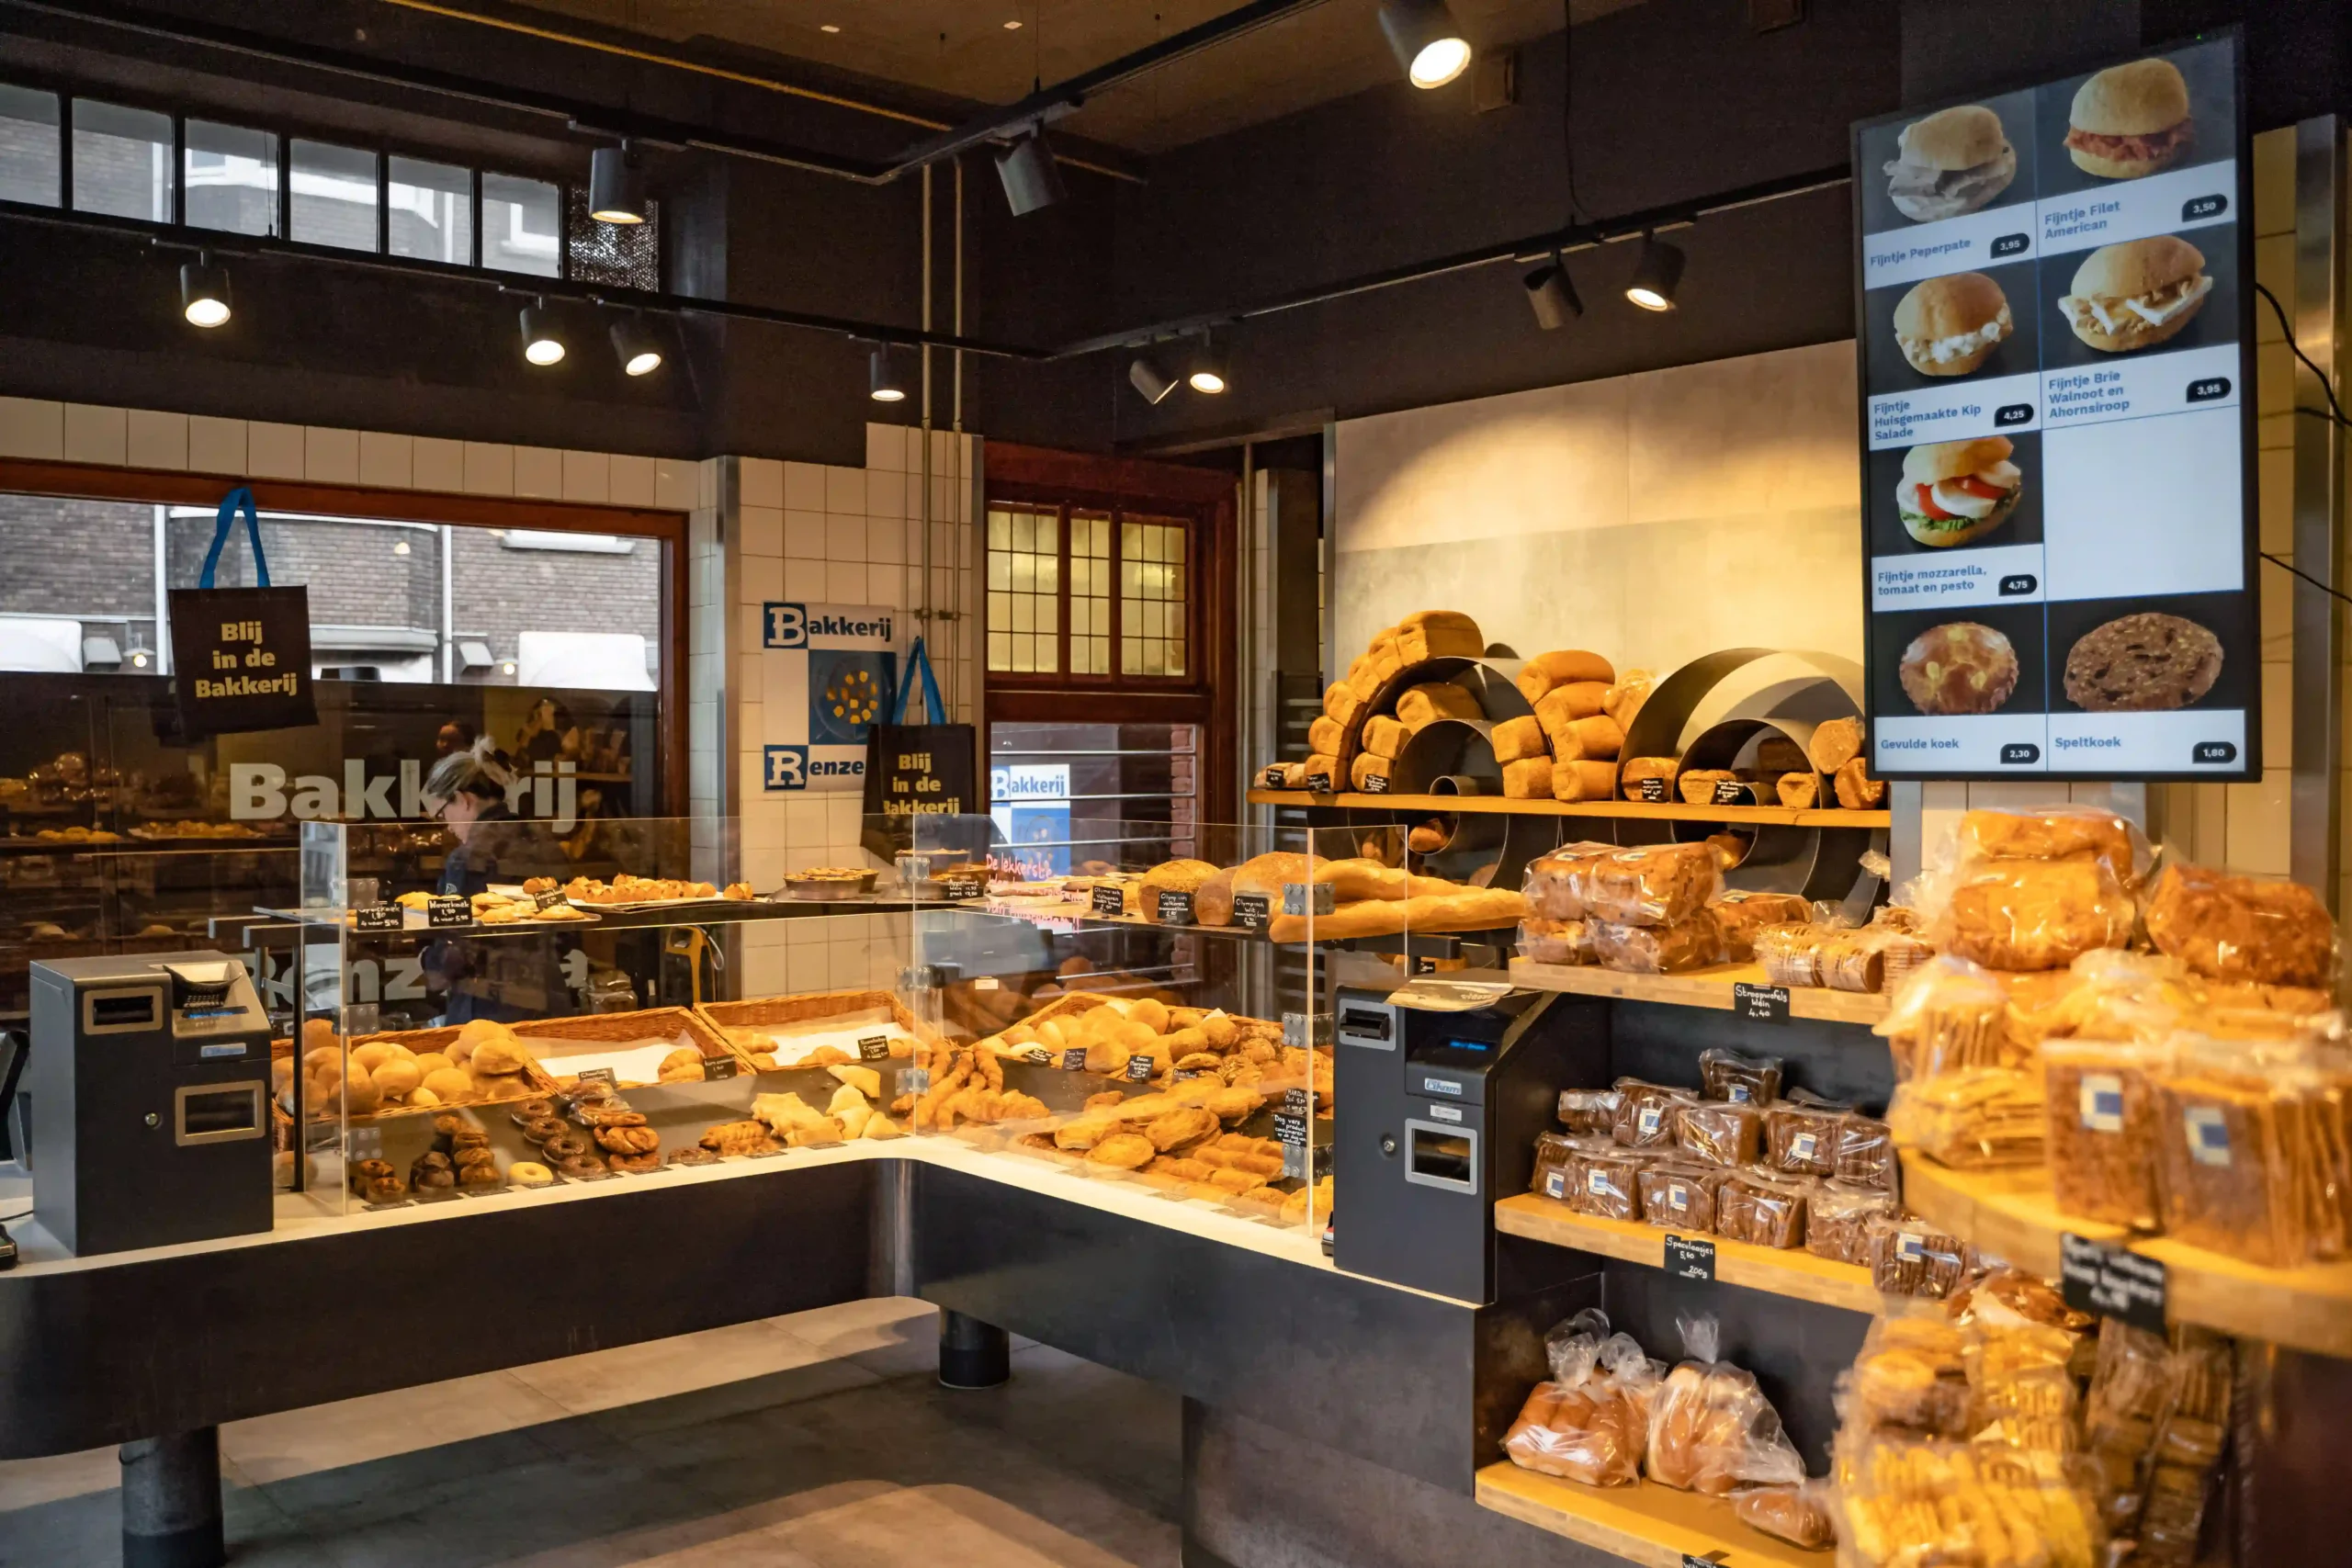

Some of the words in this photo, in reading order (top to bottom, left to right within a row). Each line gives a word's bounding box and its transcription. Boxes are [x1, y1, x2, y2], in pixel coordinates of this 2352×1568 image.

[2045, 208, 2086, 225] Fijntje
[2090, 200, 2120, 217] Filet
[2193, 201, 2216, 214] 3,50
[2045, 220, 2108, 240] American
[1870, 251, 1906, 267] Fijntje
[1909, 239, 1972, 258] Peperpate
[1999, 240, 2021, 251] 3,95
[2049, 374, 2090, 390] Fijntje
[2094, 370, 2121, 384] Brie
[2049, 389, 2105, 404] Walnoot
[2108, 386, 2124, 396] en
[2197, 384, 2221, 396] 3,95
[1873, 400, 1911, 415] Fijntje
[1874, 407, 1959, 428] Huisgemaakte
[1962, 404, 1982, 418] Kip
[2003, 410, 2025, 422] 4,25
[2049, 399, 2131, 419] Ahornsiroop
[1874, 426, 1914, 441] Salade
[1878, 570, 1914, 585] Fijntje
[1917, 564, 1987, 580] mozzarella,
[1878, 585, 1920, 596] tomaat
[1923, 584, 1938, 593] en
[1940, 580, 1975, 594] pesto
[2008, 580, 2029, 591] 4,75
[221, 621, 263, 645] Blij
[768, 606, 892, 647] Bakkerij
[212, 649, 237, 670] in
[244, 648, 276, 668] de
[195, 672, 298, 698] Bakkerij
[1881, 739, 1928, 750] Gevulde
[1930, 738, 1960, 749] koek
[2054, 736, 2121, 750] Speltkoek
[898, 752, 932, 773] Blij
[2009, 750, 2030, 759] 2,30
[2202, 748, 2225, 759] 1,80
[768, 750, 865, 786] Renze
[892, 776, 910, 793] in
[915, 776, 942, 793] de
[991, 769, 1065, 801] Bakkerij
[230, 759, 577, 834] Bakkrij
[986, 853, 999, 871] De
[1736, 985, 1788, 1003] Stroopwafels
[1666, 1236, 1714, 1258] Speculaasjes
